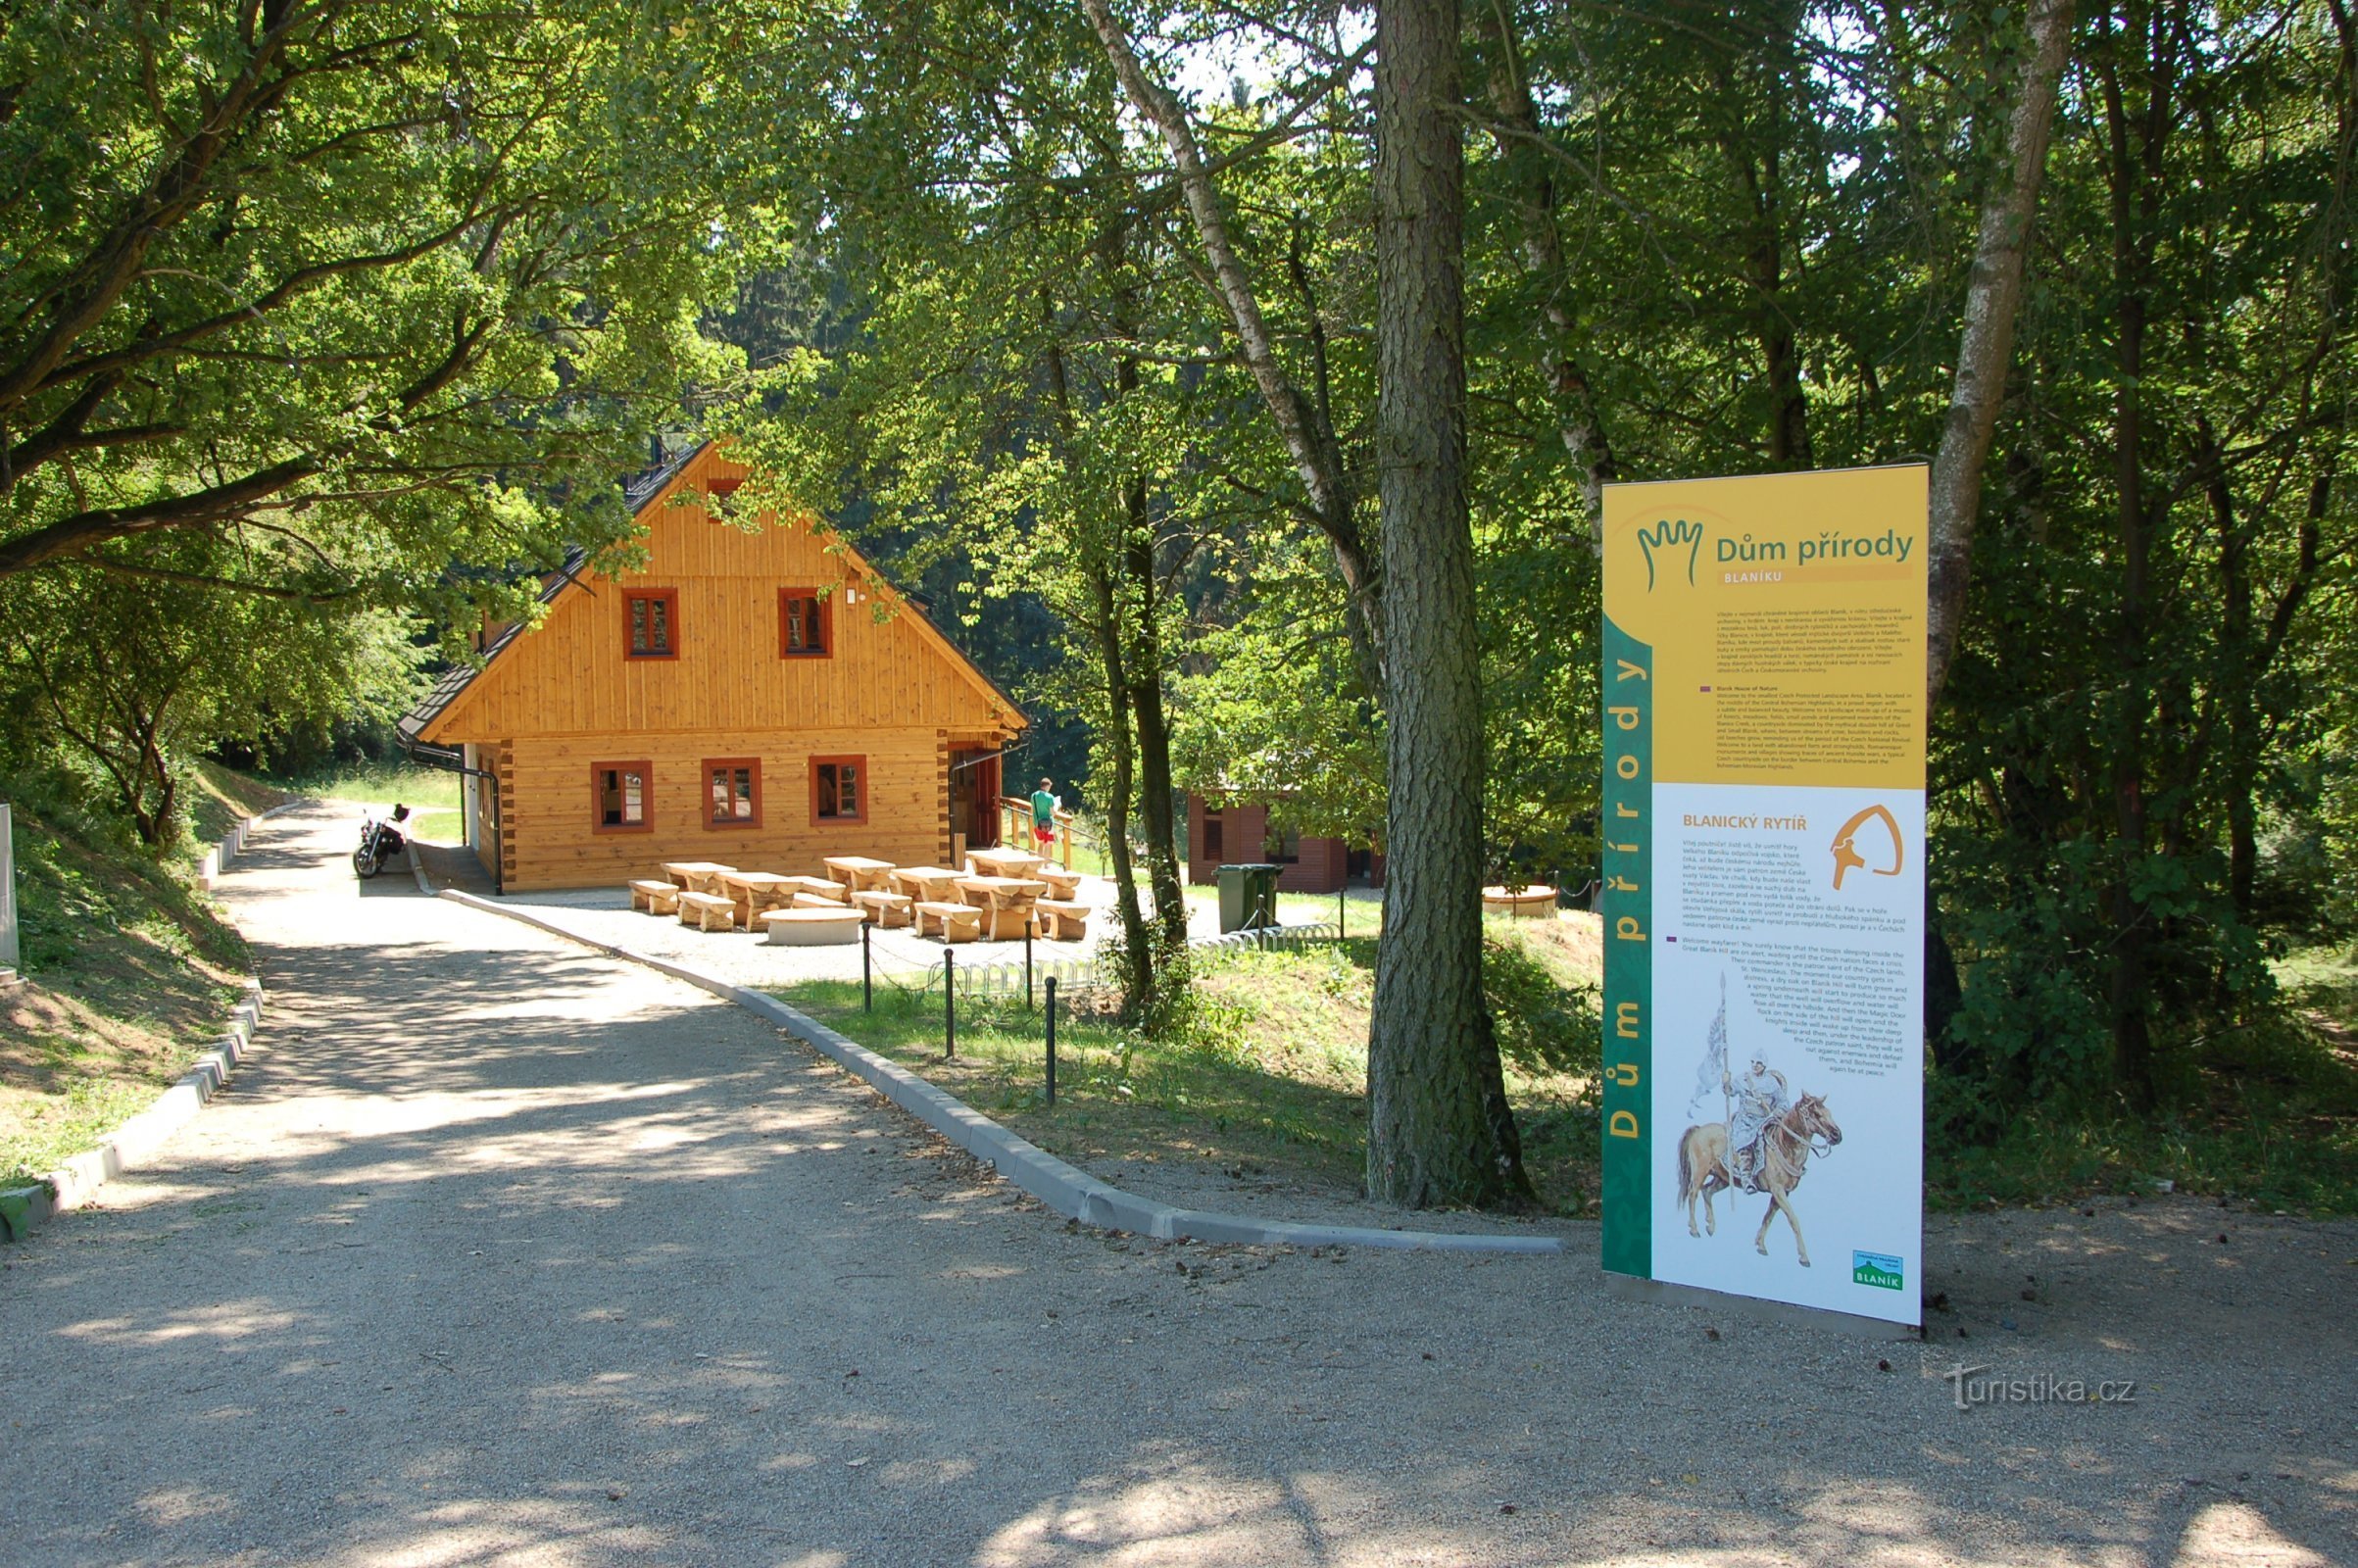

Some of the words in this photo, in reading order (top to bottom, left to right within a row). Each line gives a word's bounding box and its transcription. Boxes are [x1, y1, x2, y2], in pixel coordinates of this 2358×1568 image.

[1717, 533, 1787, 563] Dům
[1798, 529, 1913, 565] přírody
[1724, 569, 1783, 583] BLANÍKU
[1607, 659, 1647, 942] přírody
[1683, 811, 1758, 830] BLANICKÝ
[1763, 812, 1807, 831] RYTÍŘ
[1605, 1001, 1640, 1141] Dům
[1856, 1272, 1898, 1287] BLANÍK
